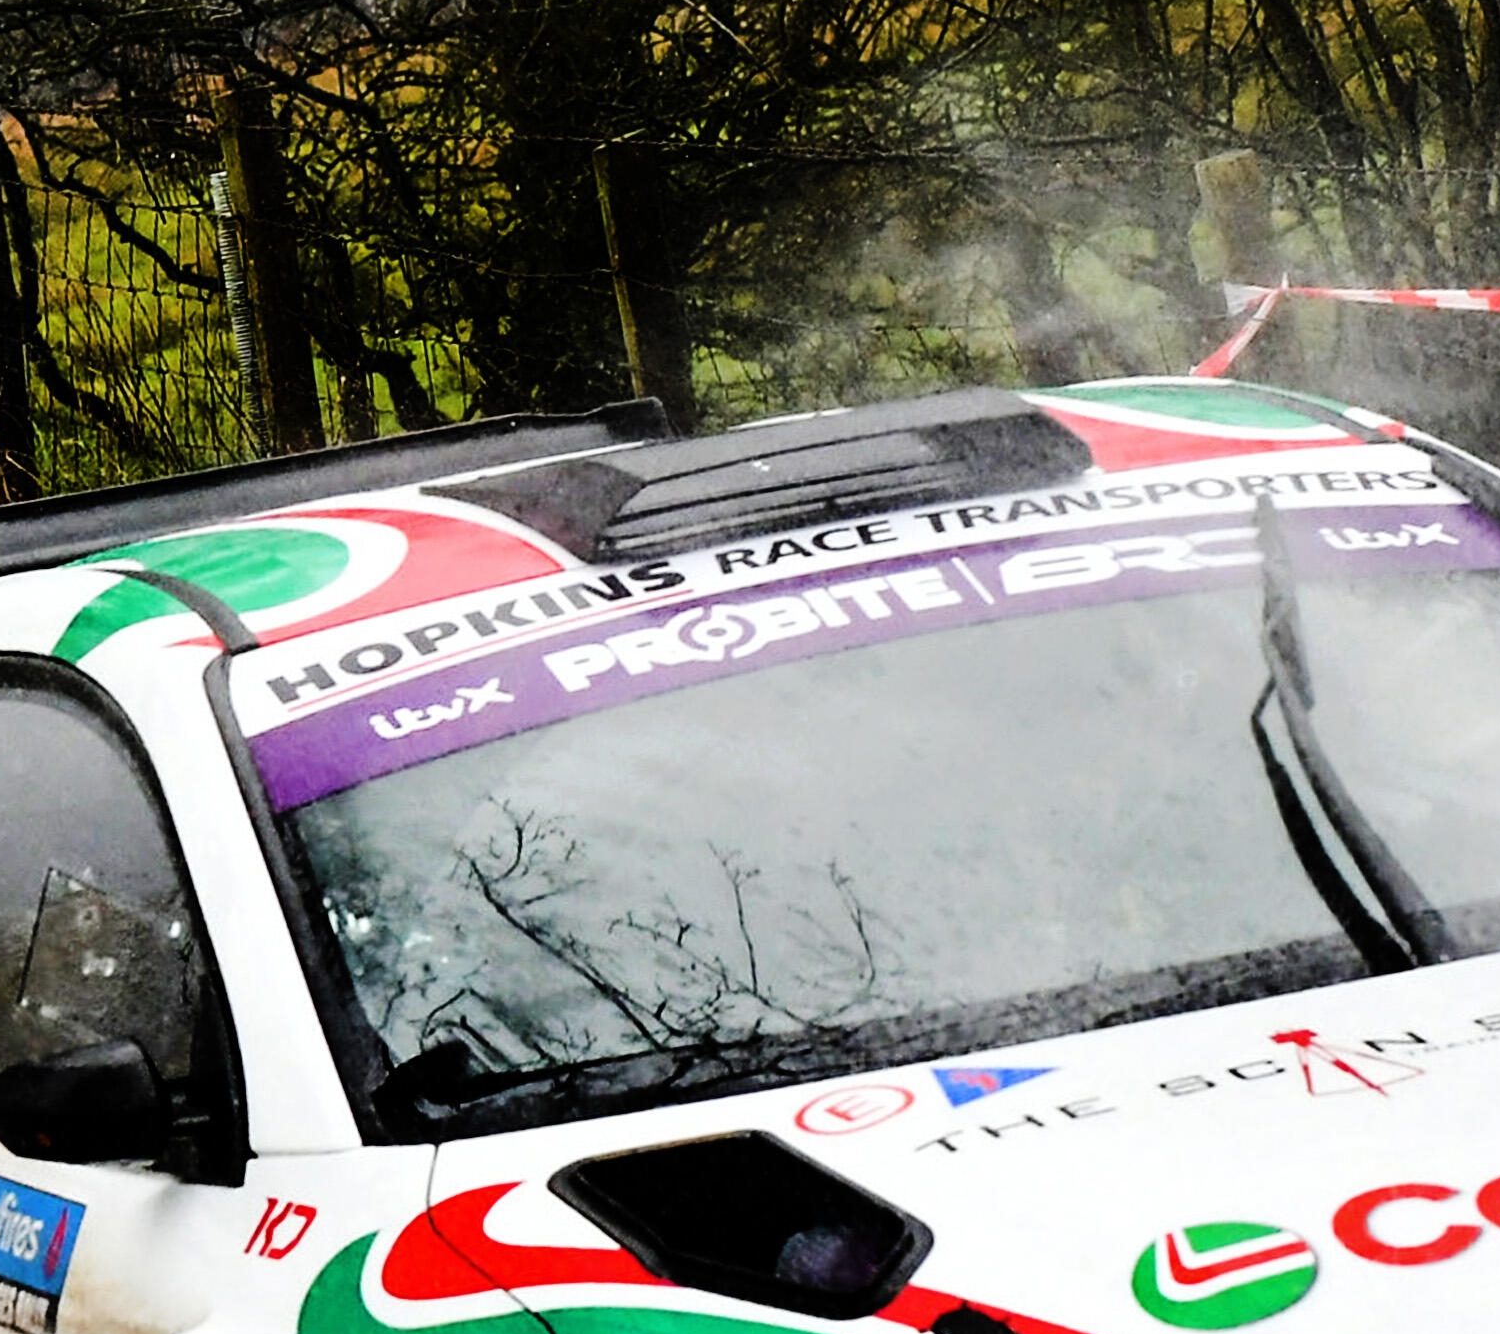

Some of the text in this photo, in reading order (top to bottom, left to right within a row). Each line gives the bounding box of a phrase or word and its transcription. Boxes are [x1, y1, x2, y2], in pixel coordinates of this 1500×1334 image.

[265, 468, 1438, 705] HOPKINS RACE TRANSPORTERS
[542, 565, 963, 693] PROBITE
[998, 526, 1265, 596] BRC
[914, 1095, 1118, 1153] THE
